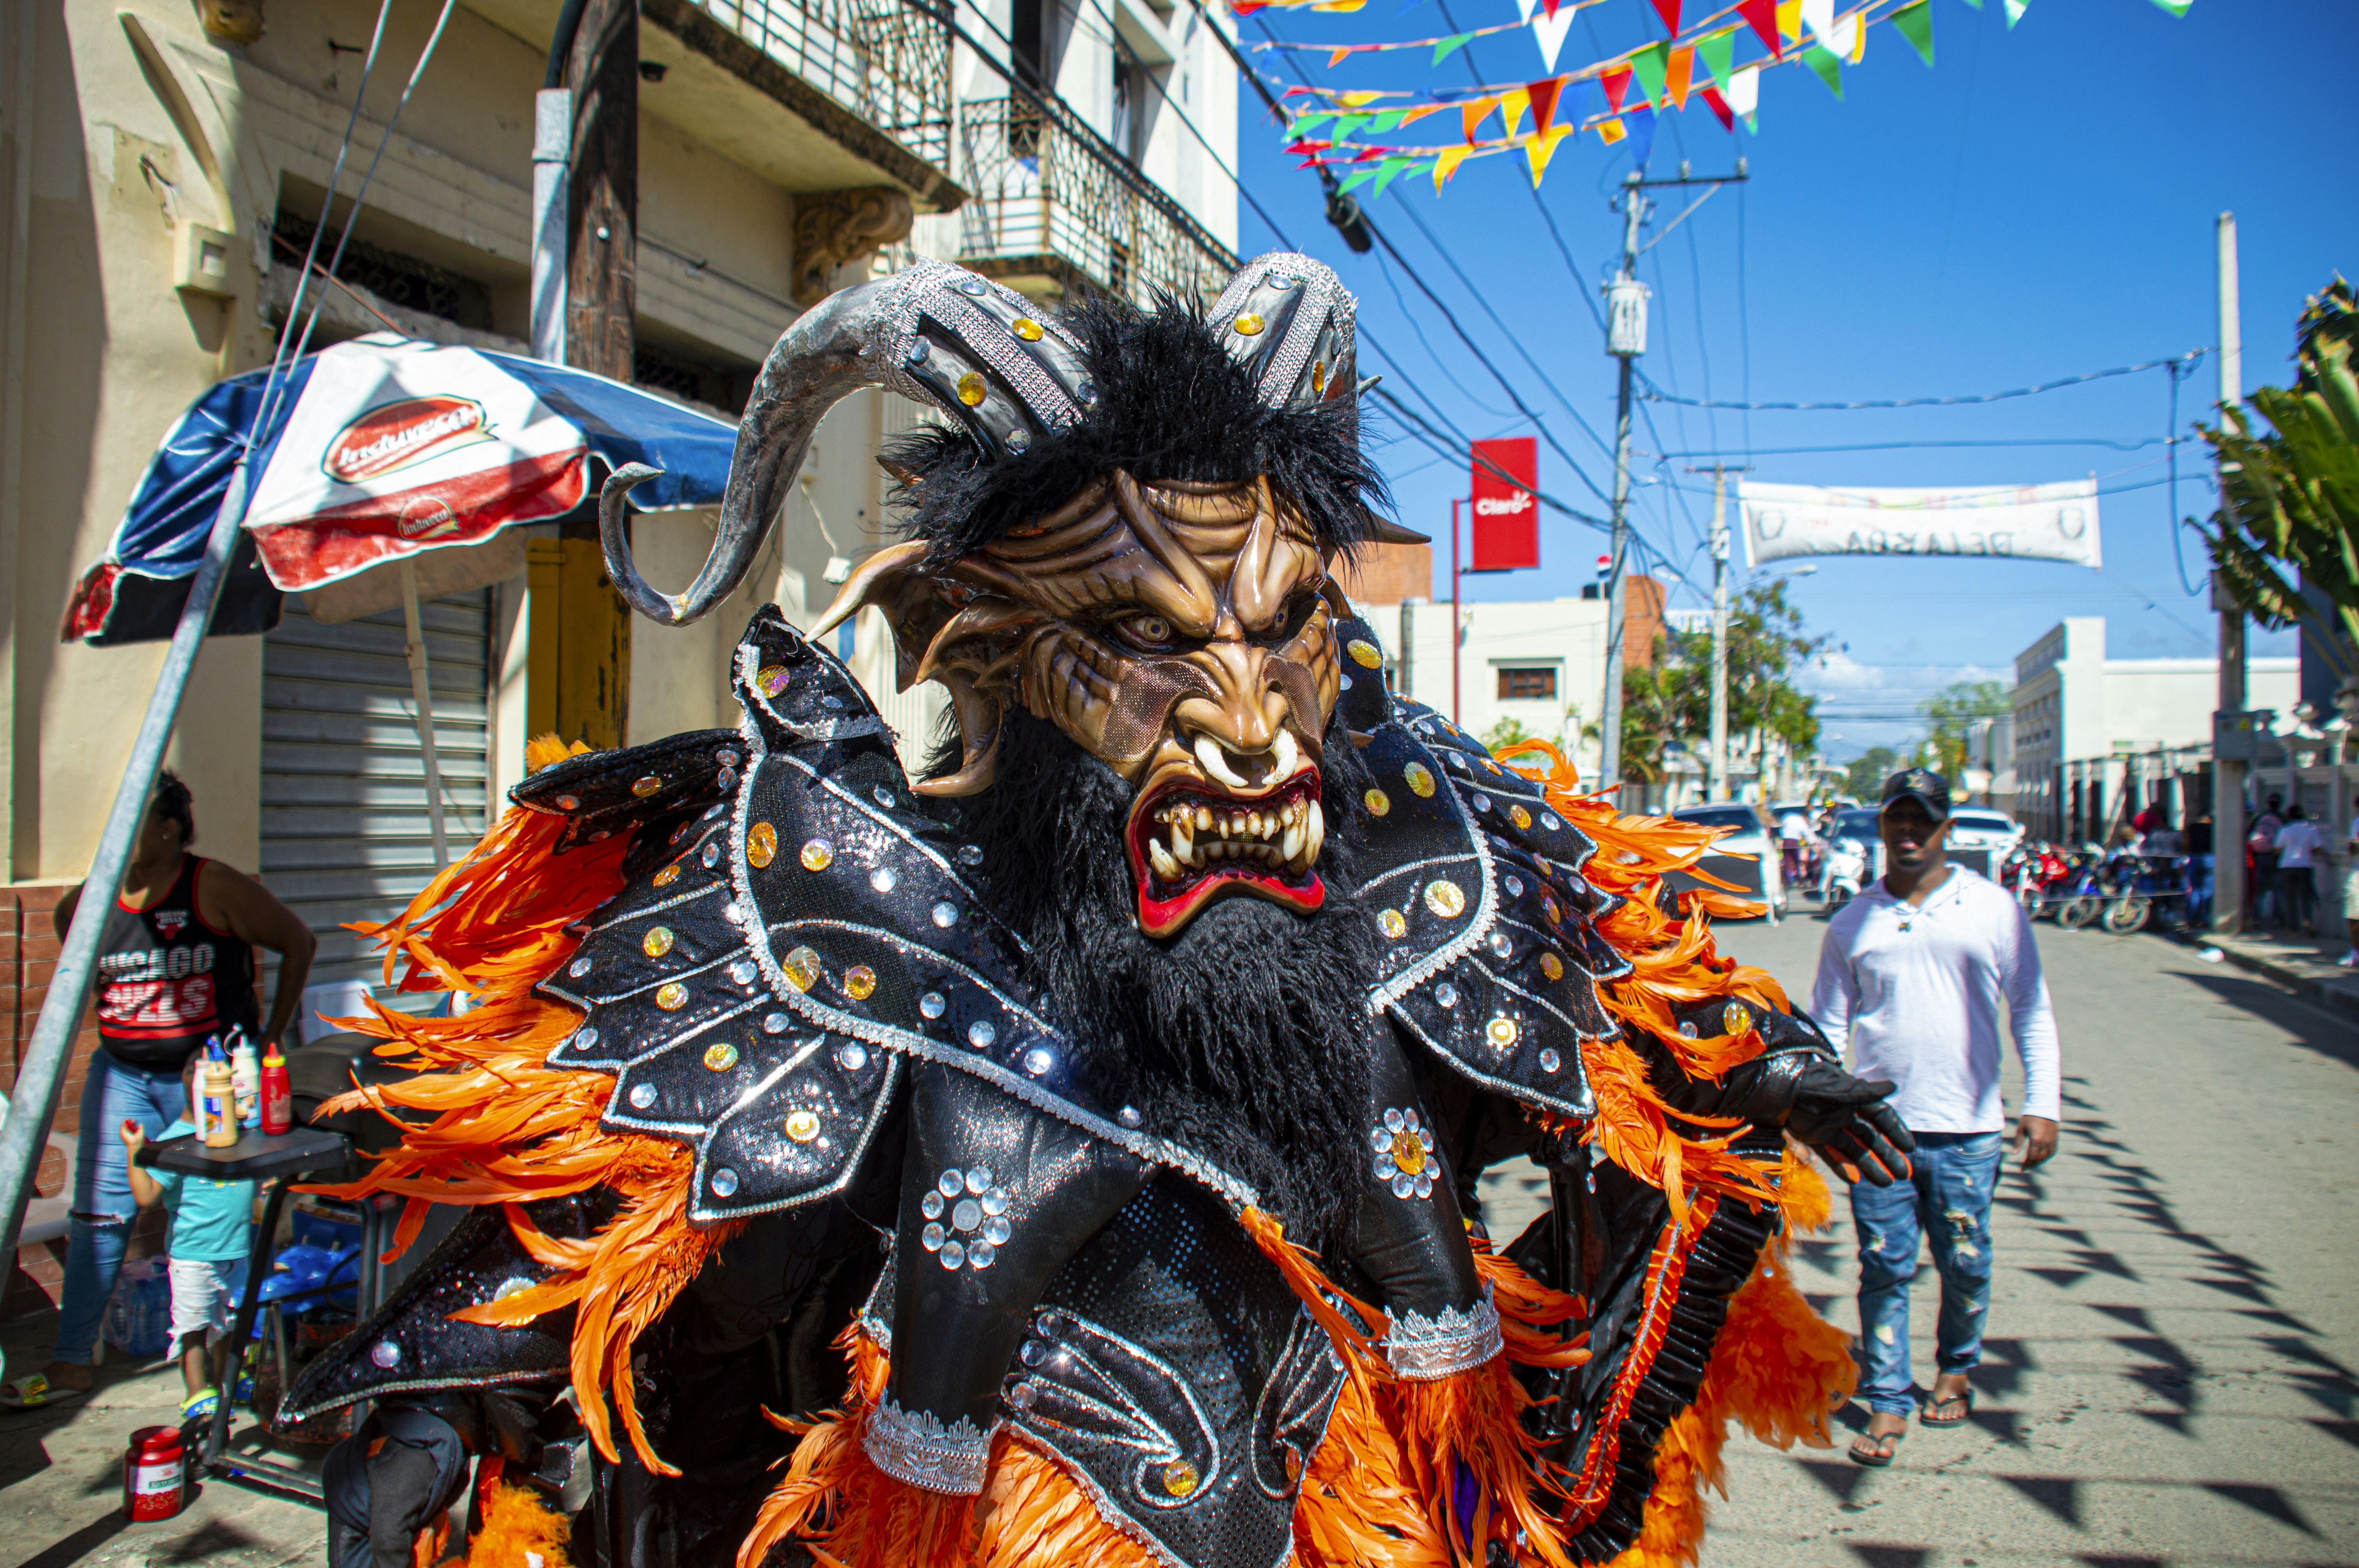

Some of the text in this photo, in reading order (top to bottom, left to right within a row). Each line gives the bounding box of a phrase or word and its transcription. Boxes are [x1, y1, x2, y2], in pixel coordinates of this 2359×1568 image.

[337, 405, 475, 466] Induveca
[1476, 495, 1525, 516] Claro
[402, 509, 449, 536] Induveca
